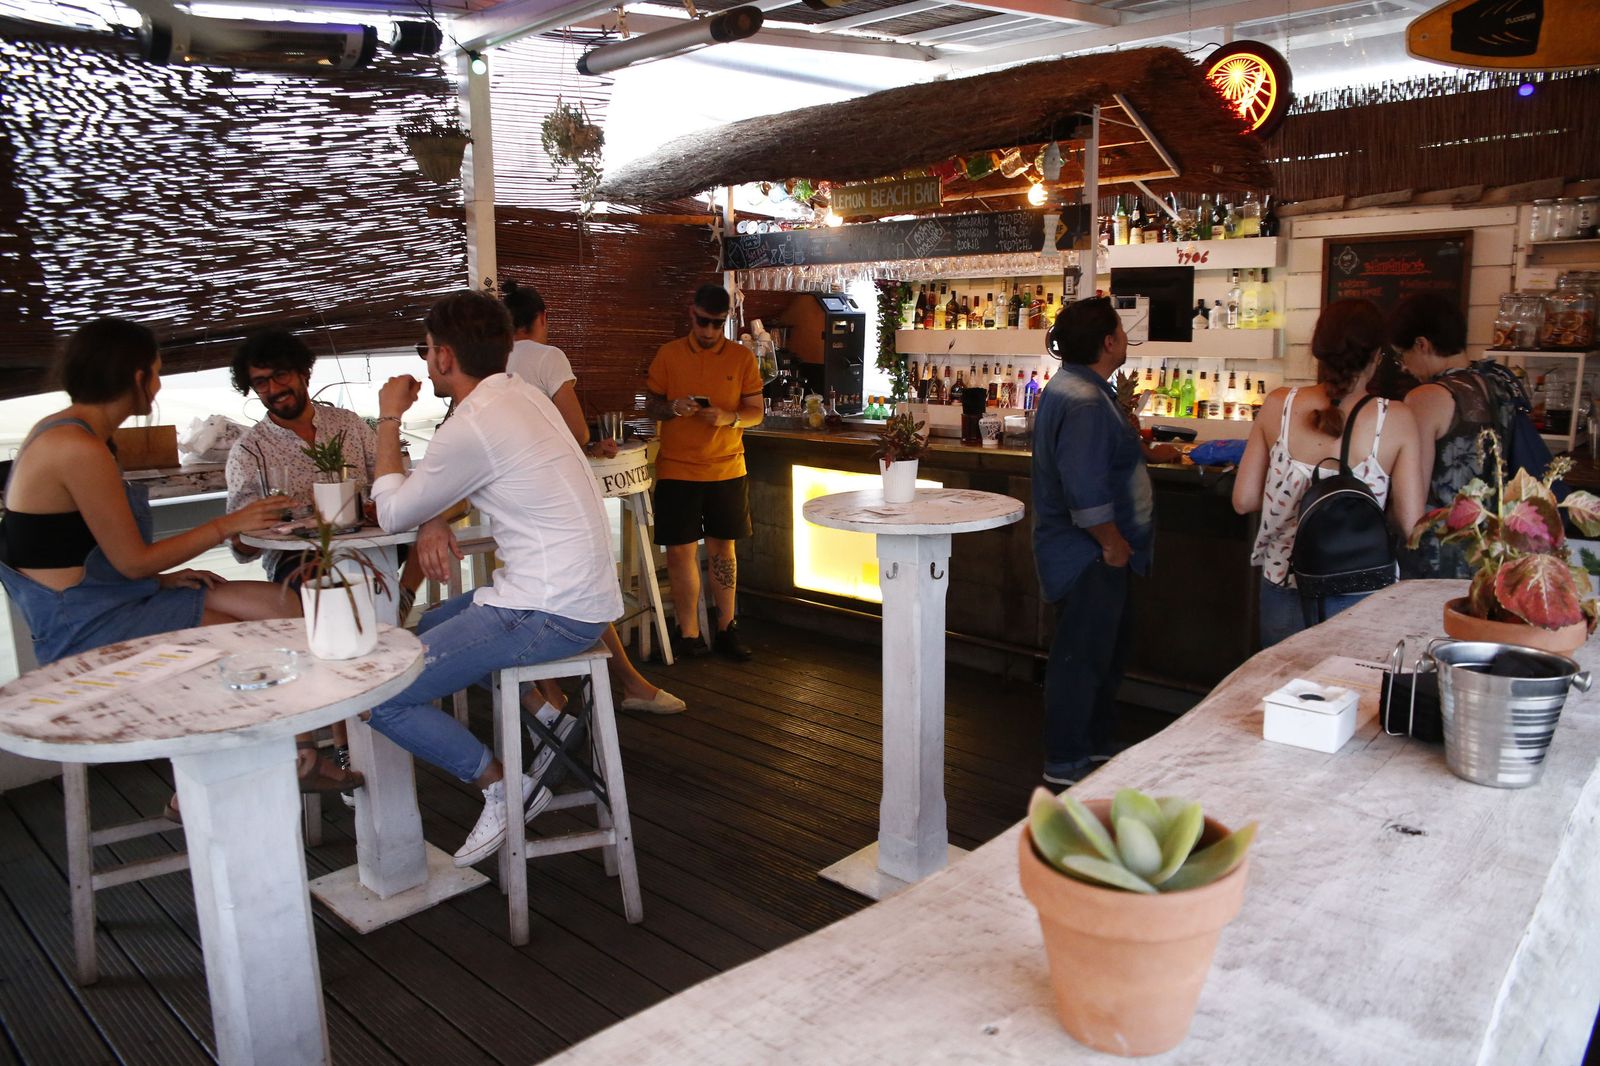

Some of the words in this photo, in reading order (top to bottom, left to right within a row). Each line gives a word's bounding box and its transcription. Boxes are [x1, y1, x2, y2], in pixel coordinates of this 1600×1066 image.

[833, 191, 866, 209] LEMON
[870, 185, 910, 208] BEACH
[914, 181, 938, 204] BAR
